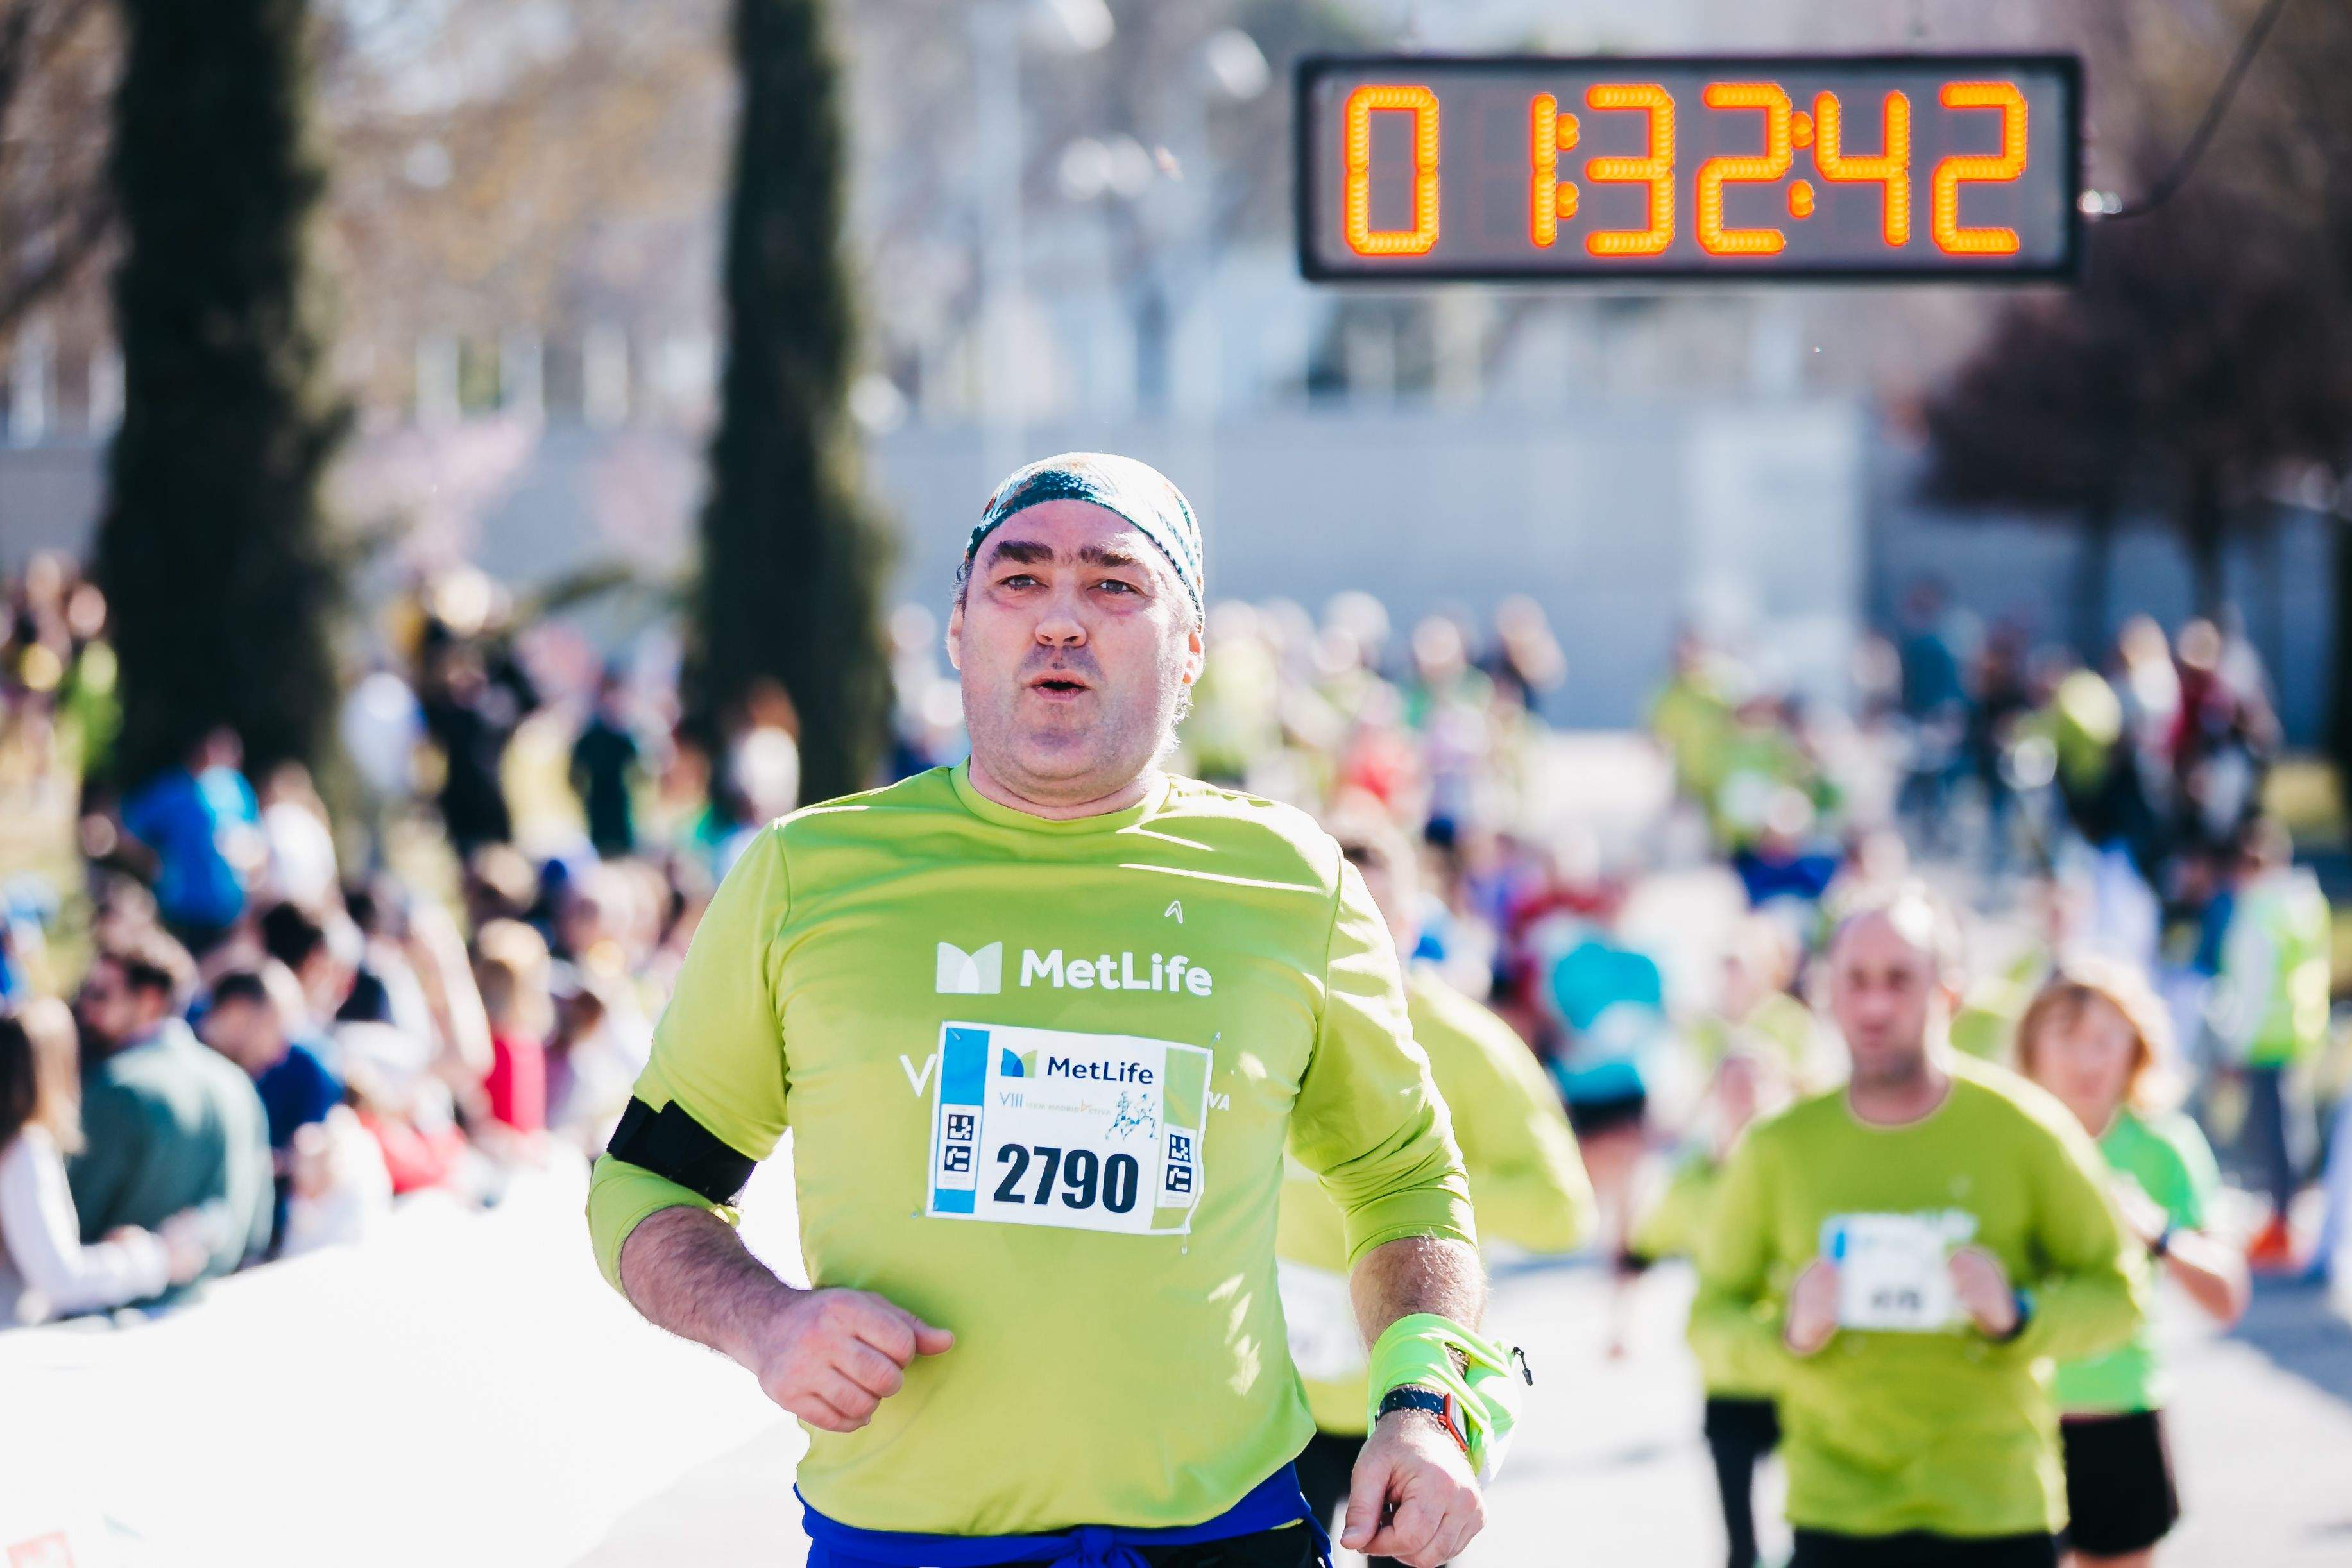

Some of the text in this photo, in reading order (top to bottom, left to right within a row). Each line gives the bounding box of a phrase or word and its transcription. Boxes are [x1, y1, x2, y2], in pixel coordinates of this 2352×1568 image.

[1020, 948, 1213, 996] MetLife
[1047, 1056, 1154, 1085] MetLife
[1000, 1091, 1023, 1108] VIII
[993, 1143, 1140, 1213] 2790
